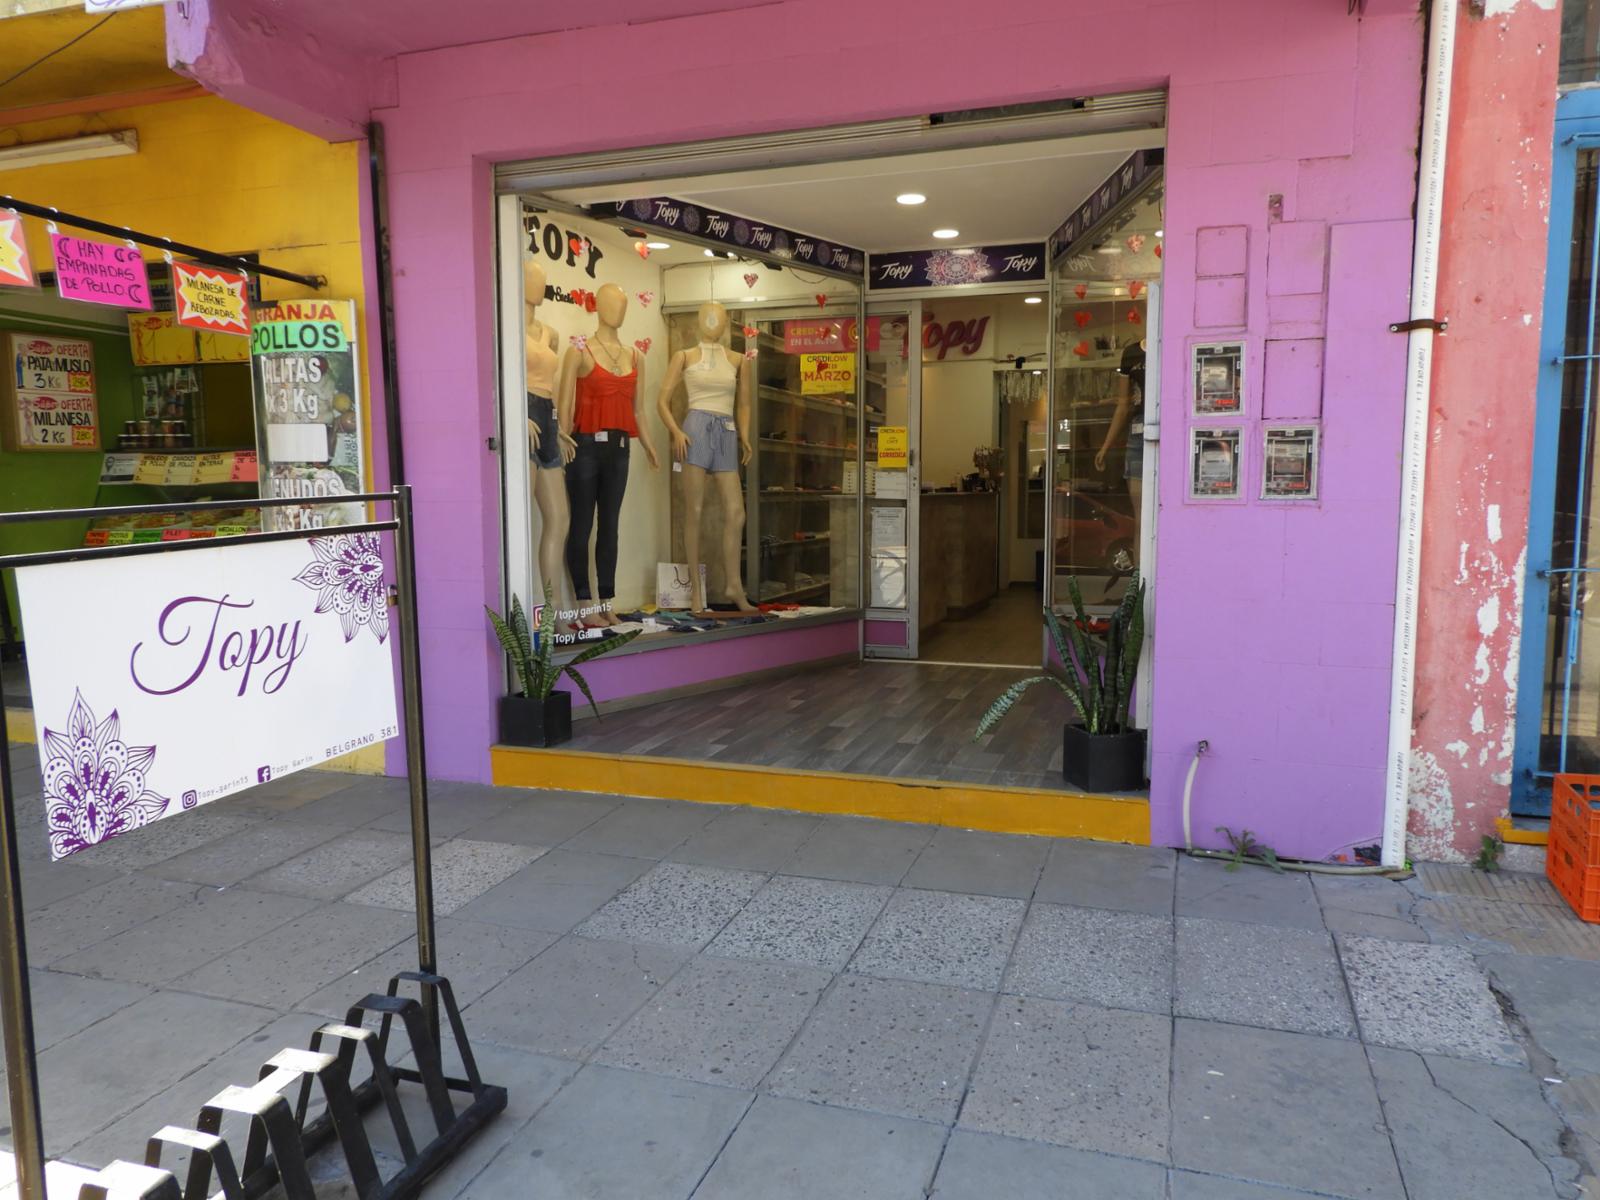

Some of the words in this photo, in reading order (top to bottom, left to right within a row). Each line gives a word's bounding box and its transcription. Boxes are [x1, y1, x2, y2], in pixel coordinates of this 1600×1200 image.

[654, 201, 680, 226] Topy
[705, 215, 730, 238] Topy
[750, 227, 772, 248] Topy
[77, 240, 104, 261] HAY
[794, 239, 814, 260] Topy
[831, 249, 850, 269] Topy
[57, 256, 136, 281] EMPANADAS
[879, 262, 913, 280] Topy
[1001, 254, 1038, 273] Topy
[62, 276, 78, 290] DE
[82, 276, 126, 296] POLLO
[186, 278, 224, 294] MILANESA
[227, 287, 237, 297] DE
[197, 292, 226, 307] CARNE
[253, 323, 340, 351] POLLOS
[56, 344, 89, 358] OFERTA
[34, 373, 47, 388] 3
[804, 370, 852, 382] MARZO
[61, 397, 93, 412] OFERTA
[293, 388, 318, 419] Kg
[33, 411, 92, 426] MILANESA
[41, 428, 49, 443] 2
[272, 478, 339, 498] ENUDOS
[559, 608, 579, 620] topy
[580, 601, 612, 618] garin15
[130, 593, 309, 697] Topy
[554, 632, 576, 644] Topy
[325, 733, 375, 757] BELGRANO
[380, 725, 397, 738] 381
